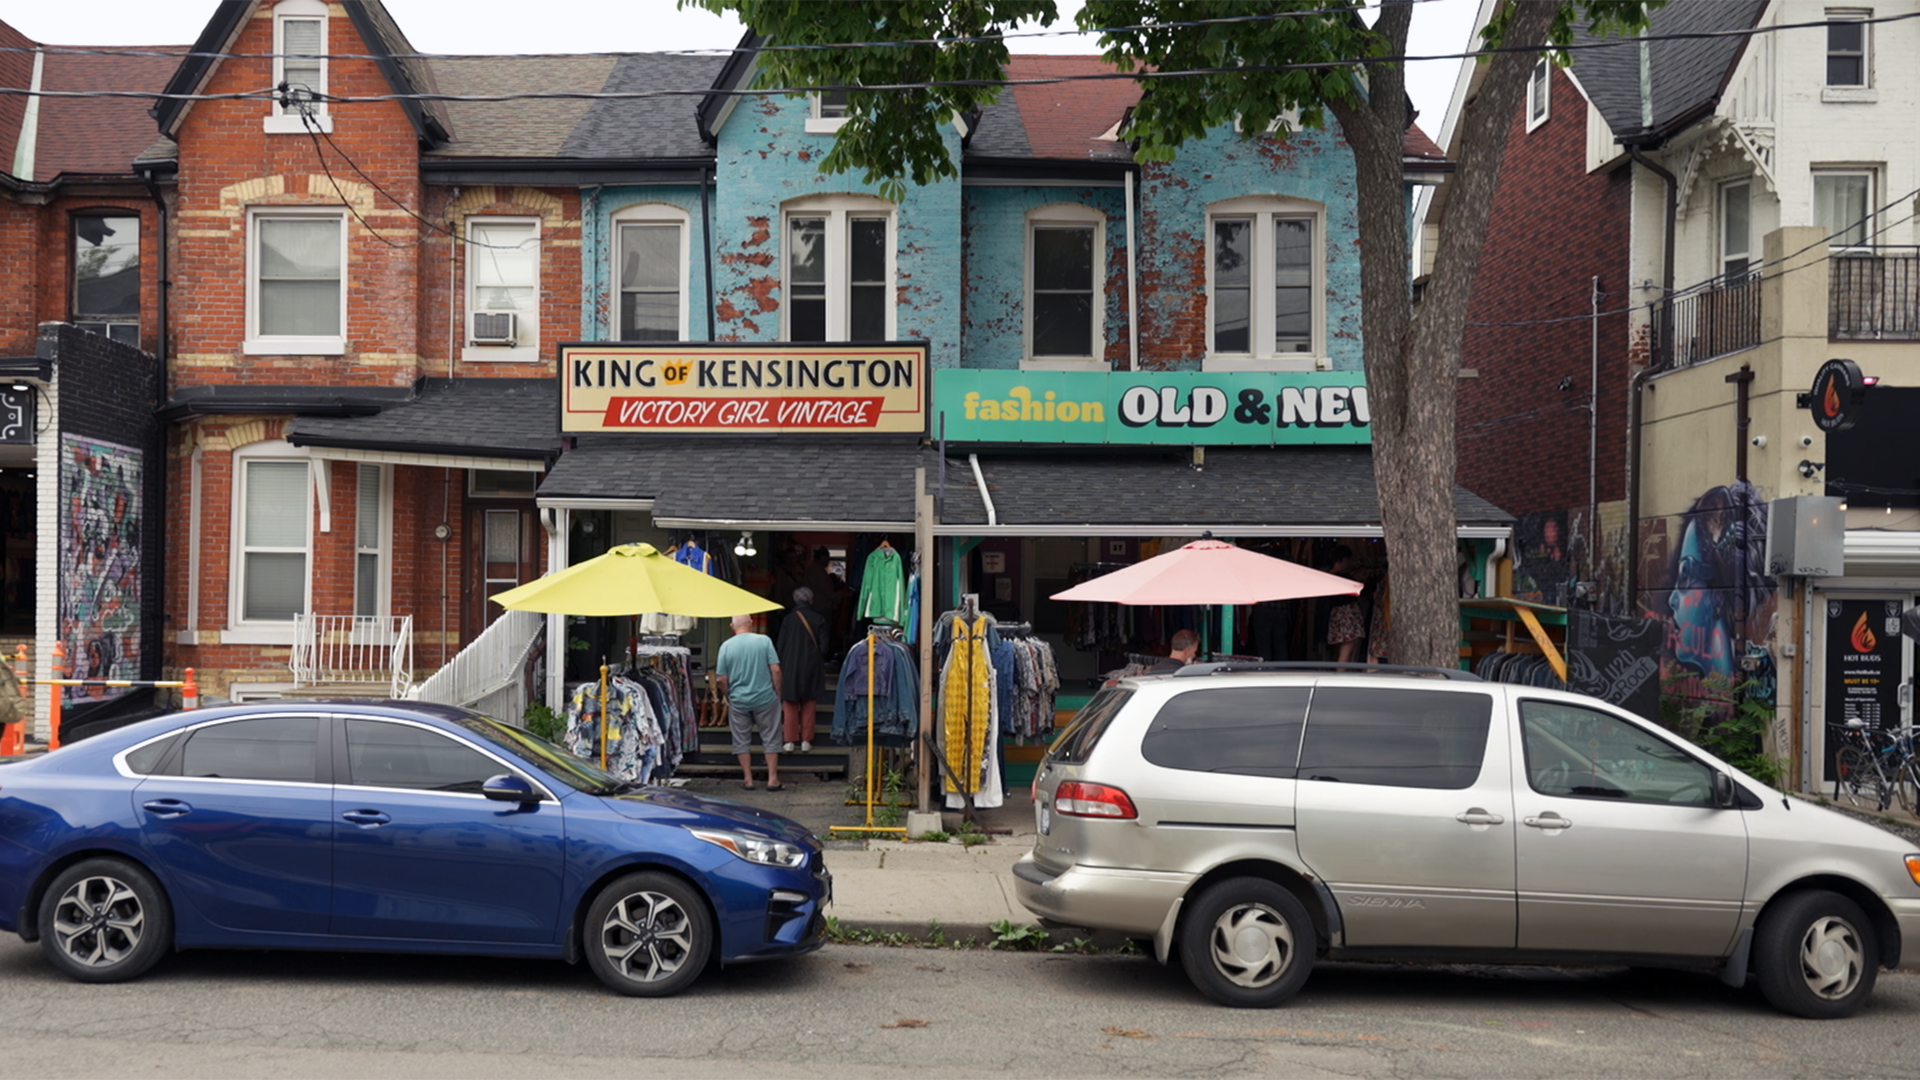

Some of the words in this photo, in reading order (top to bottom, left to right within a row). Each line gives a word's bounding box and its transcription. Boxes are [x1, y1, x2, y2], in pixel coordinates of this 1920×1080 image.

[574, 359, 656, 388] KING
[664, 366, 688, 381] OF
[698, 359, 912, 388] KENSINGTON
[619, 400, 716, 424] VICTORY
[717, 401, 770, 425] GIRL
[777, 401, 873, 424] VINTAGE
[963, 386, 1105, 422] fashion
[1119, 385, 1228, 428] OLD
[1234, 388, 1271, 425] &
[1346, 894, 1426, 909] SIENNA
